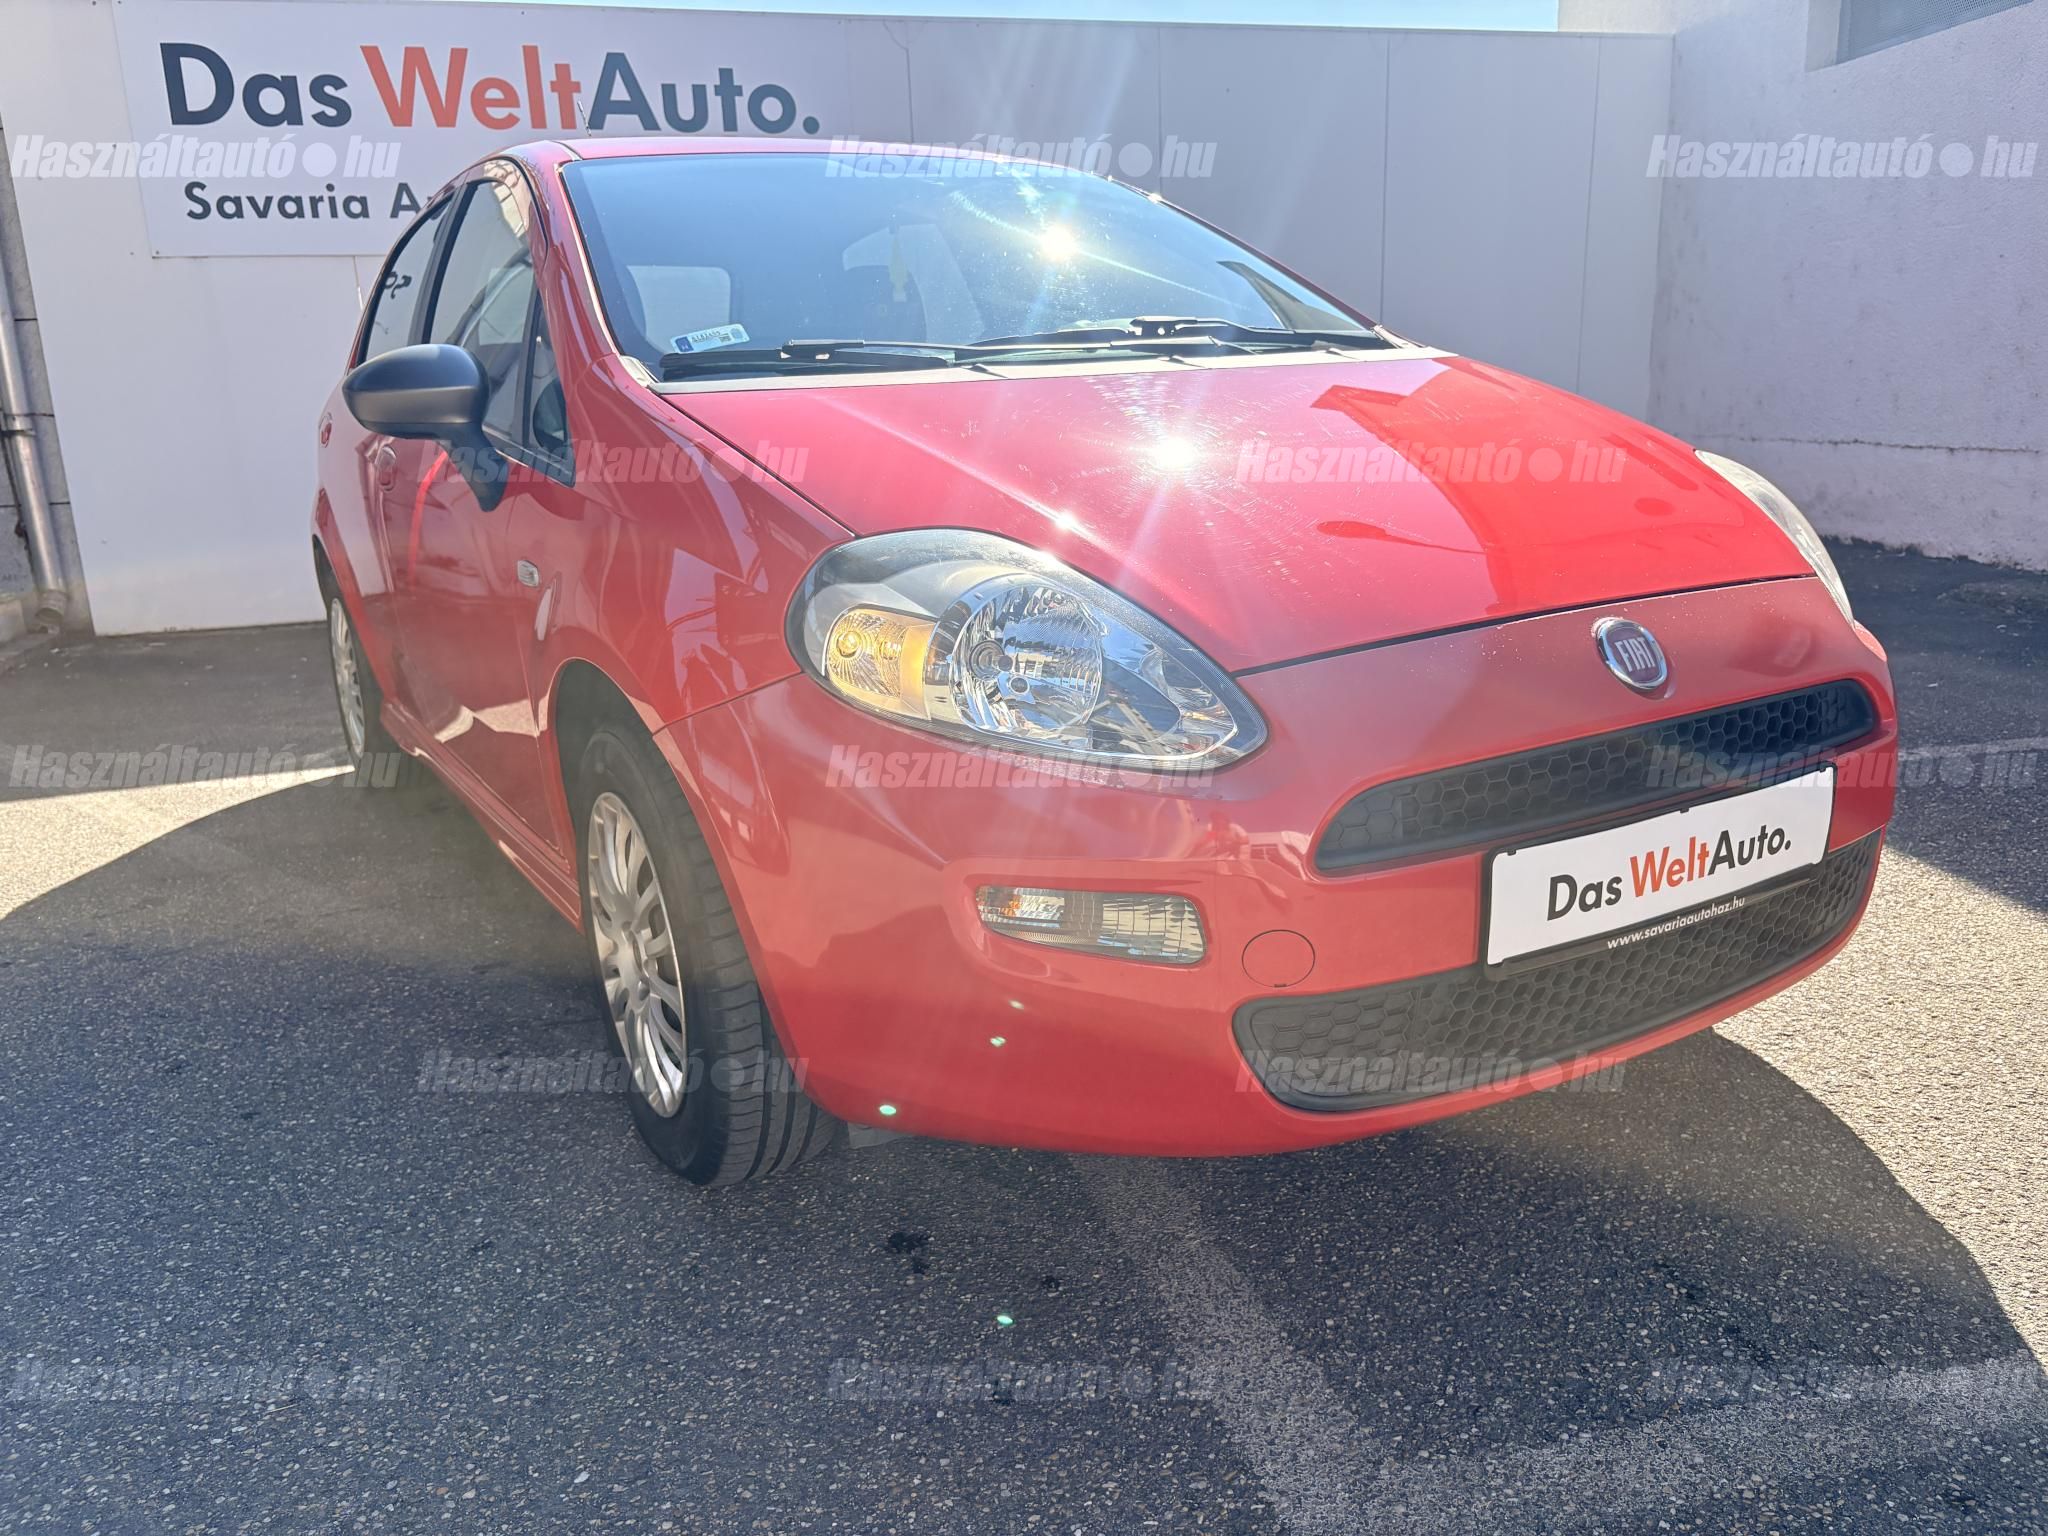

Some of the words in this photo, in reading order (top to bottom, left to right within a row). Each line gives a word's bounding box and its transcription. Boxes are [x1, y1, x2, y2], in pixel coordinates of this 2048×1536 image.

[160, 42, 352, 128] Das
[360, 45, 820, 135] WeltAuto.
[184, 181, 370, 219] Savaria
[1614, 637, 1656, 673] FIAT
[1547, 874, 1622, 922] Das
[1629, 825, 1792, 898] WeltAuto.
[1606, 897, 1746, 950] www.savariaautohaz.hu
